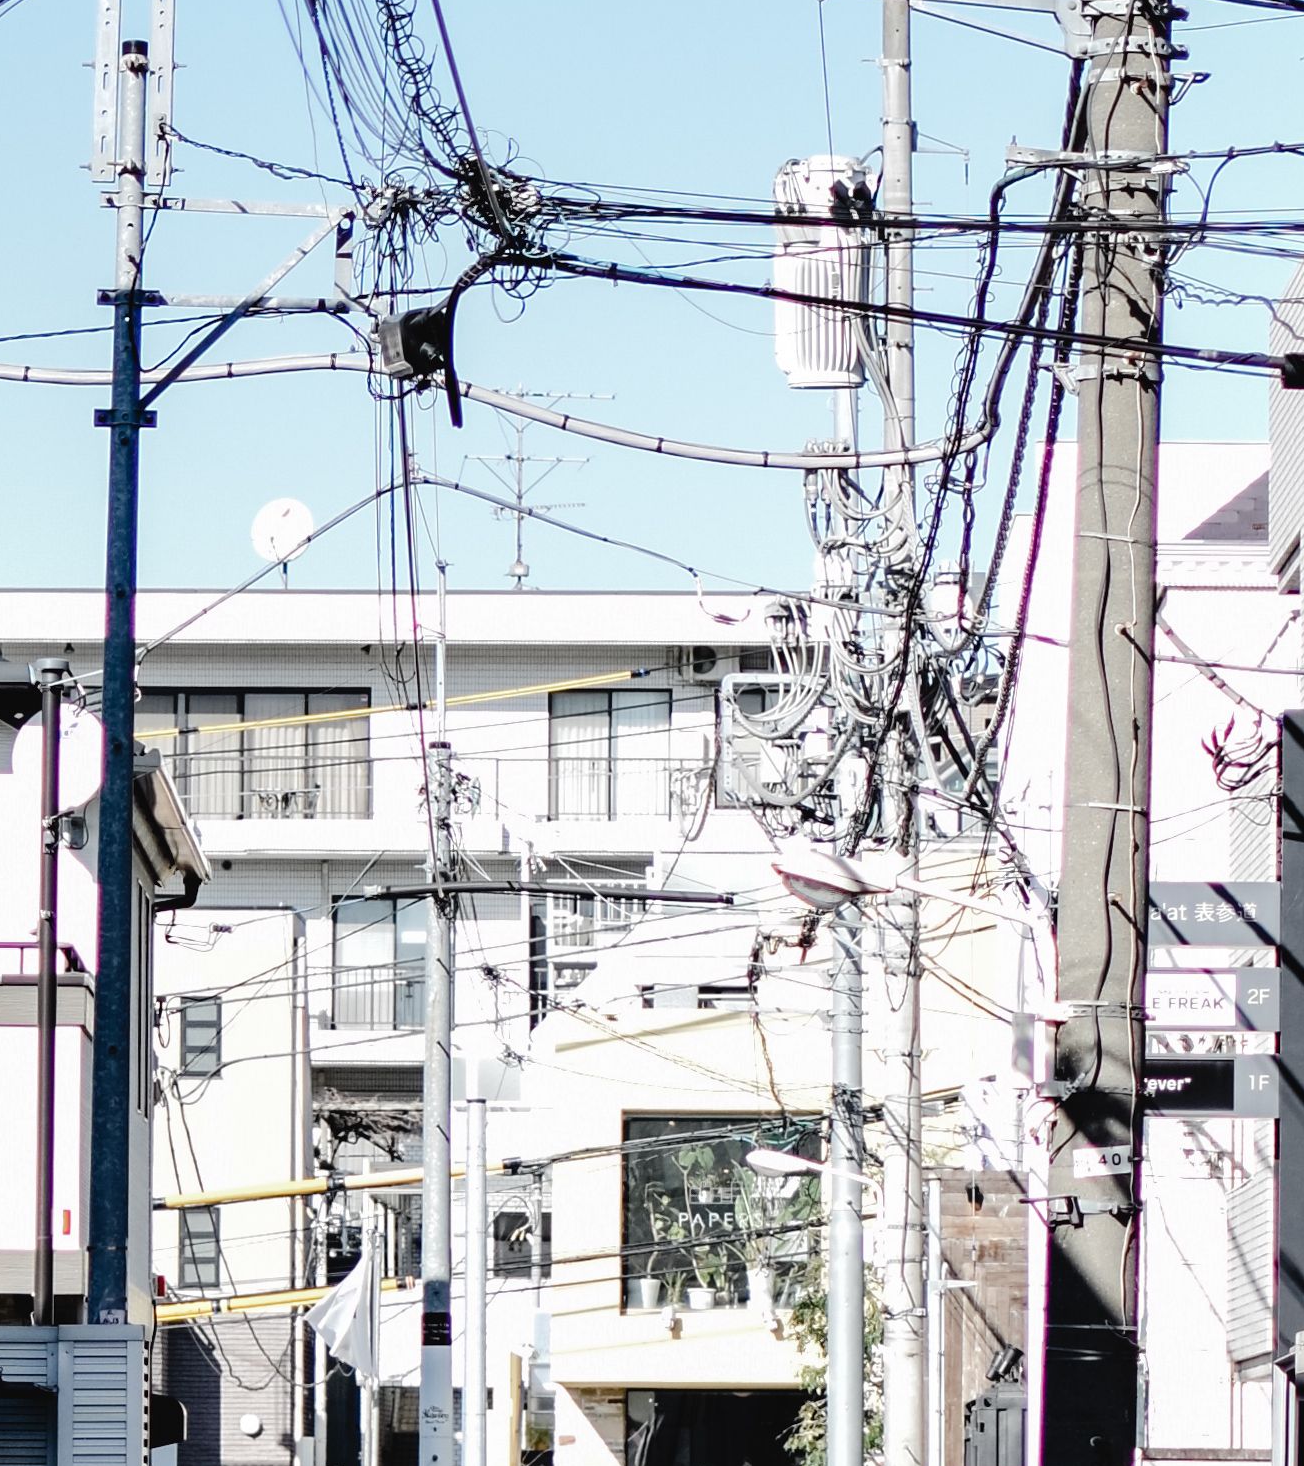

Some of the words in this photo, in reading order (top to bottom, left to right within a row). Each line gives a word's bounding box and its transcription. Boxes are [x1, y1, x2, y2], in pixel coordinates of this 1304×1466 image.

[1194, 901, 1258, 923] 表参道
[1168, 997, 1225, 1010] FREAK
[1247, 988, 1271, 1005] 2F
[1143, 1077, 1192, 1091] ever"
[1248, 1074, 1270, 1091] 1F
[678, 1212, 764, 1228] PAPERS
